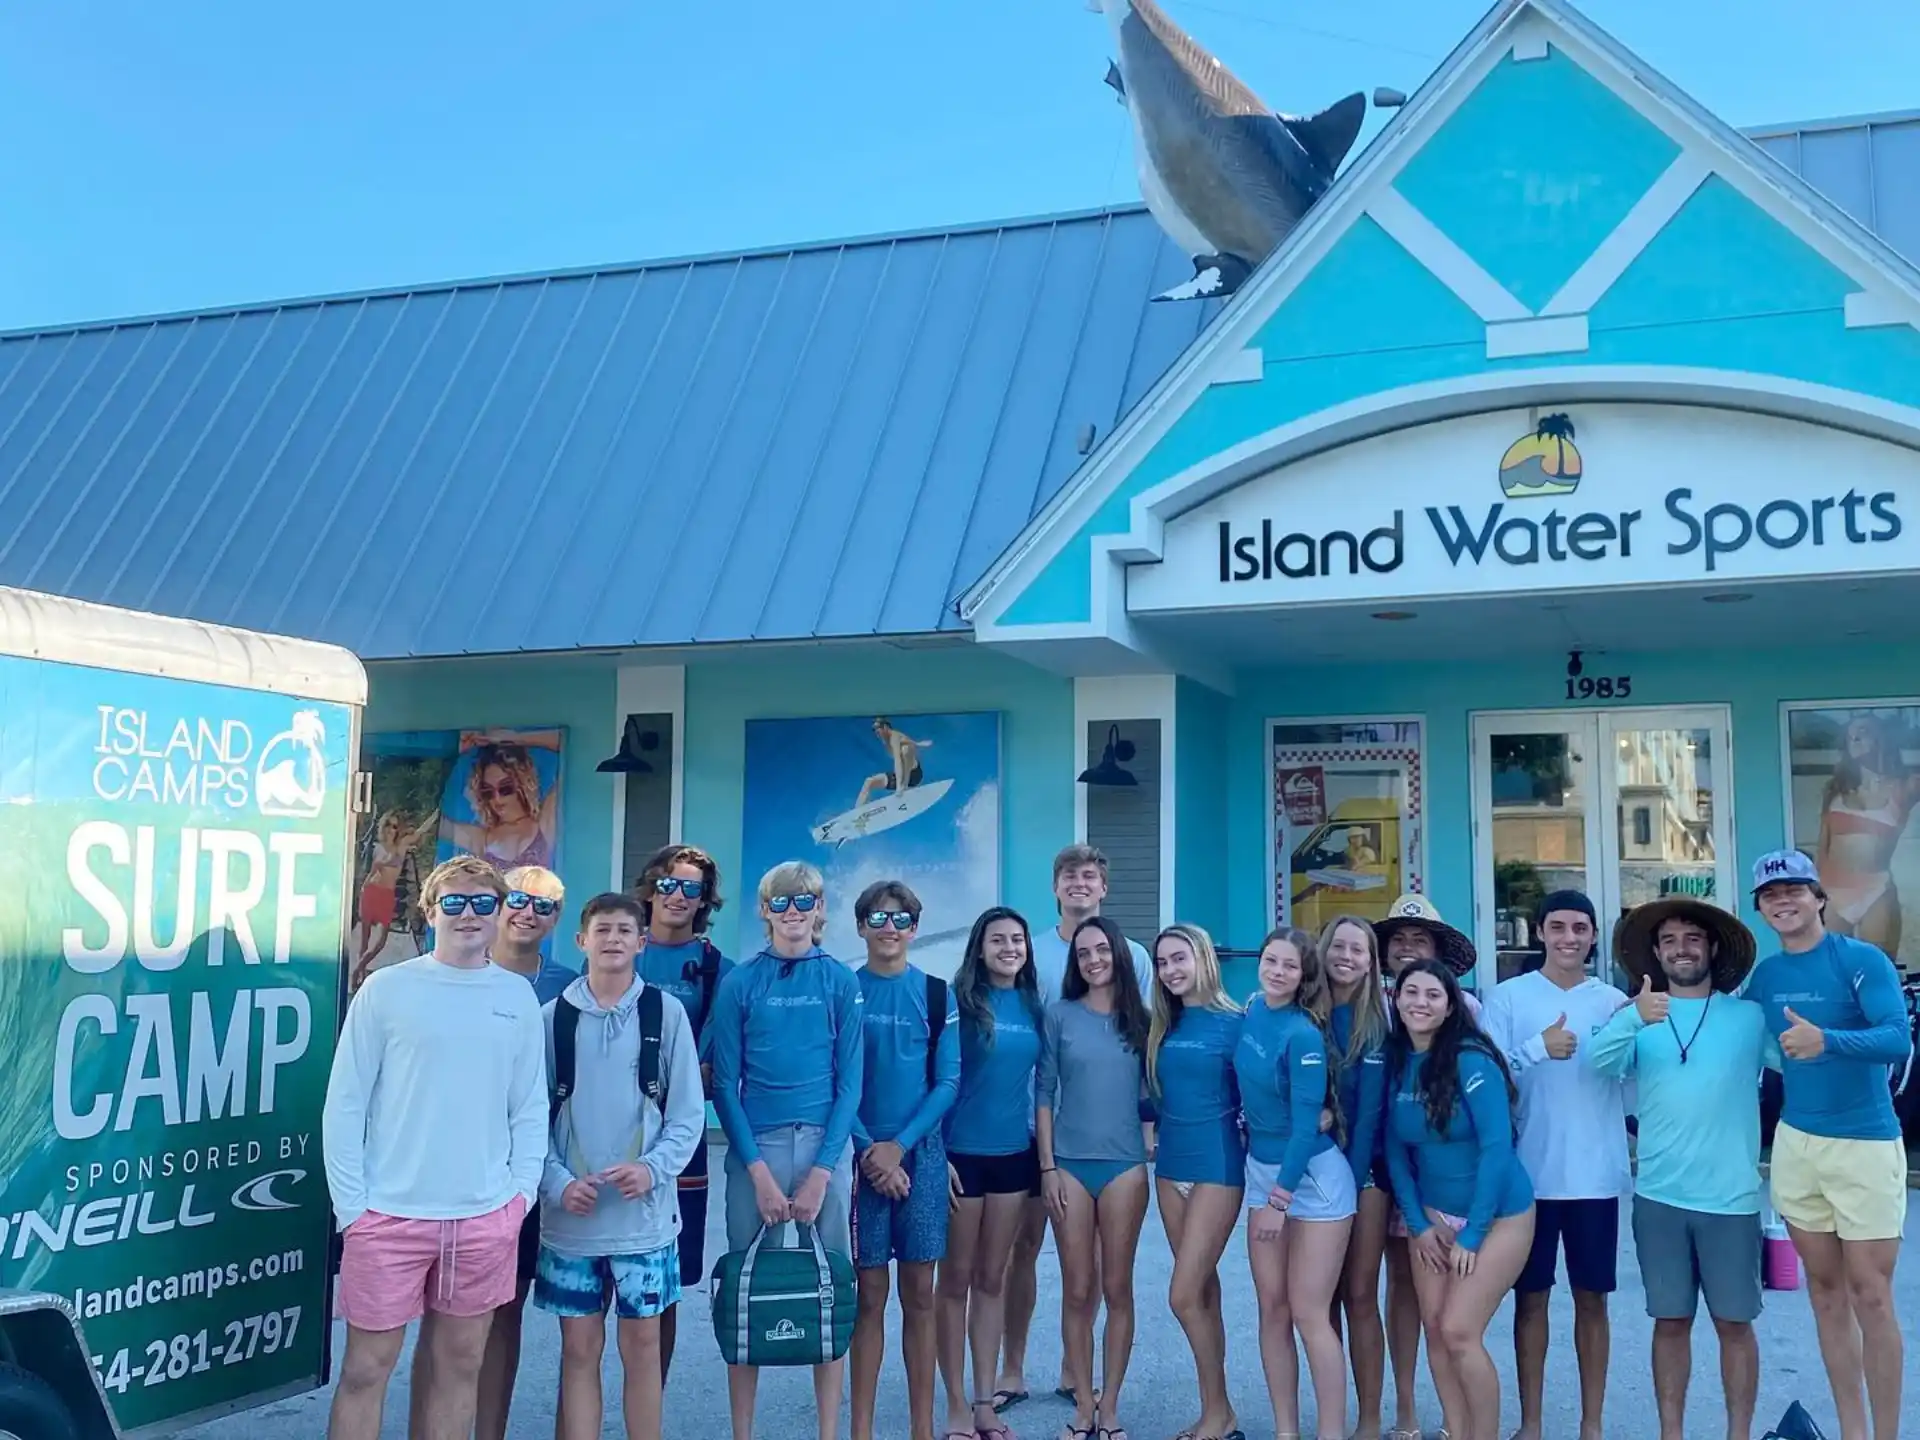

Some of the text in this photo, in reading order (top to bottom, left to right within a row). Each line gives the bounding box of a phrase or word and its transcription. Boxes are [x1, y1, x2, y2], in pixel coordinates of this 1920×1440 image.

[1219, 487, 1903, 583] Island Water Sports
[1565, 675, 1632, 700] 1985
[94, 705, 252, 764] ISLAND
[93, 756, 249, 808] CAMPS
[62, 820, 323, 974] SURF
[52, 987, 312, 1140] CAMP
[65, 1133, 310, 1192] SPONSORED BY
